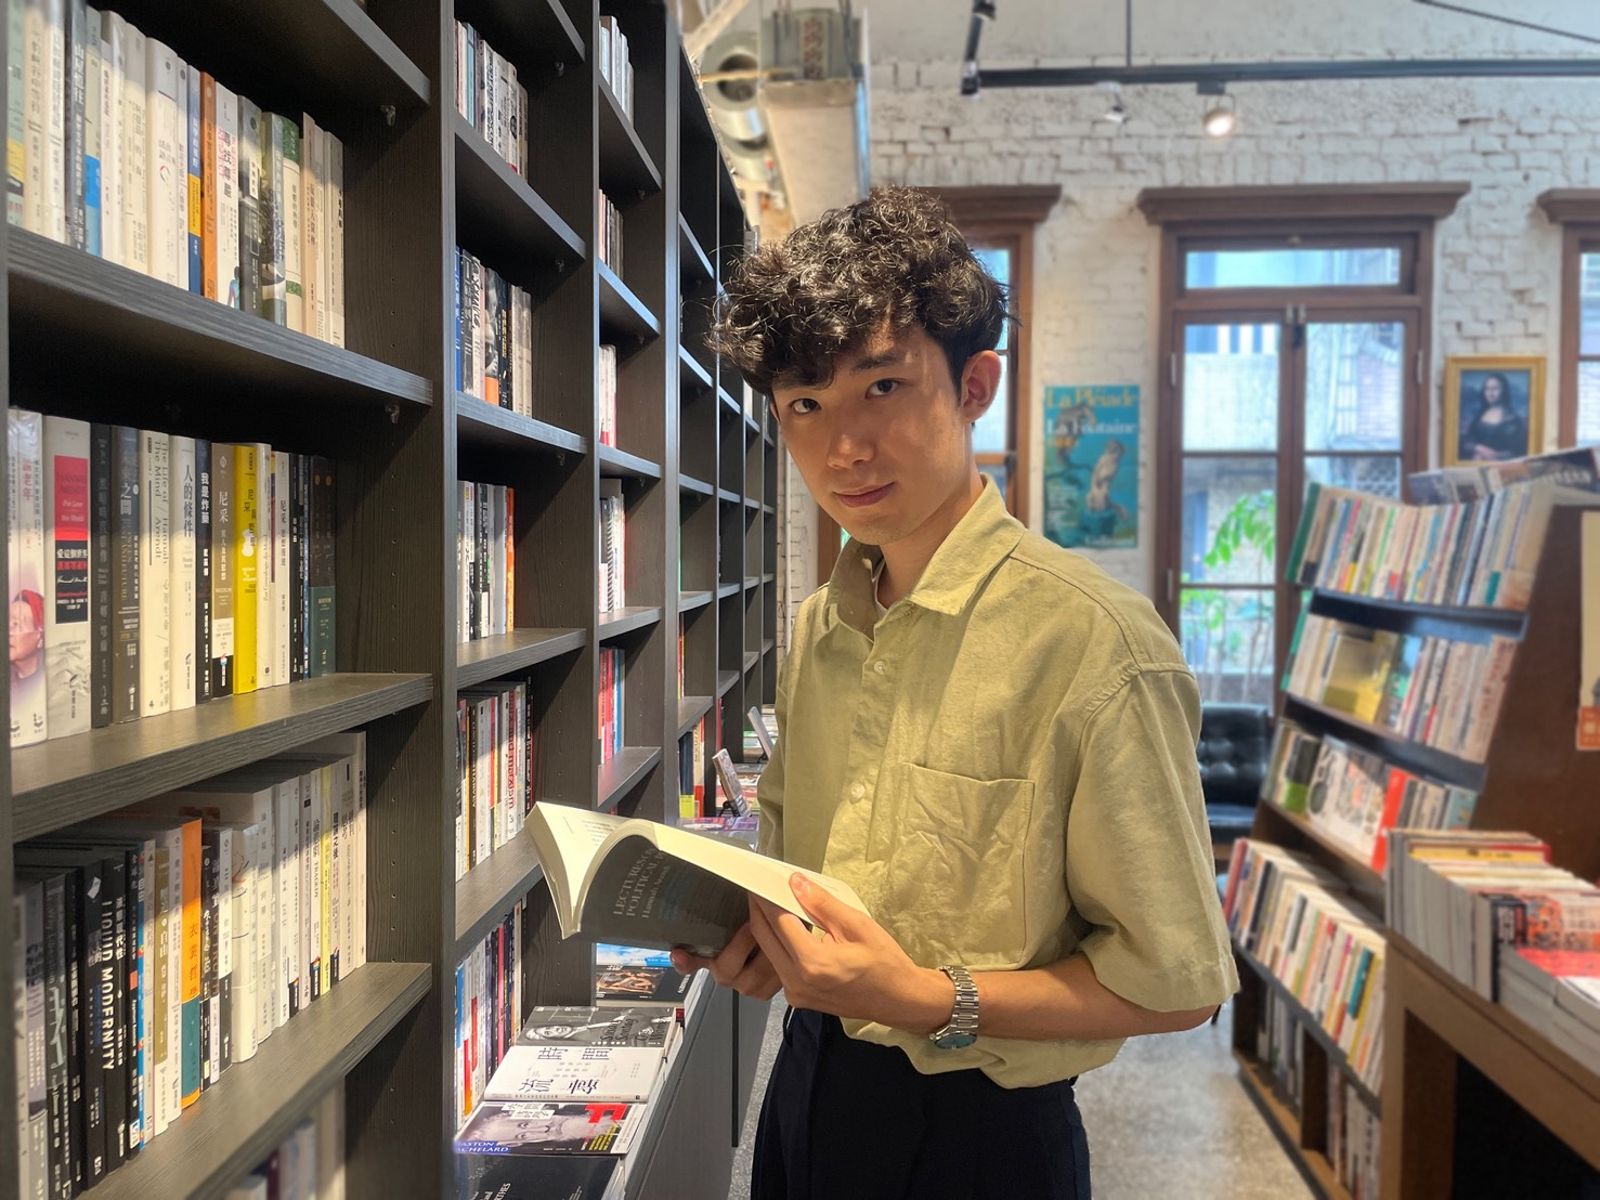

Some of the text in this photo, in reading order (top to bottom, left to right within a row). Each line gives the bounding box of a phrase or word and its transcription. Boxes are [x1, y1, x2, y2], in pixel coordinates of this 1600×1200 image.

[183, 464, 193, 538] 人的條件
[219, 491, 229, 523] 尼采
[613, 858, 647, 915] LECTURES
[625, 863, 657, 916] POLITICAL
[102, 966, 115, 1070] MODERNITY
